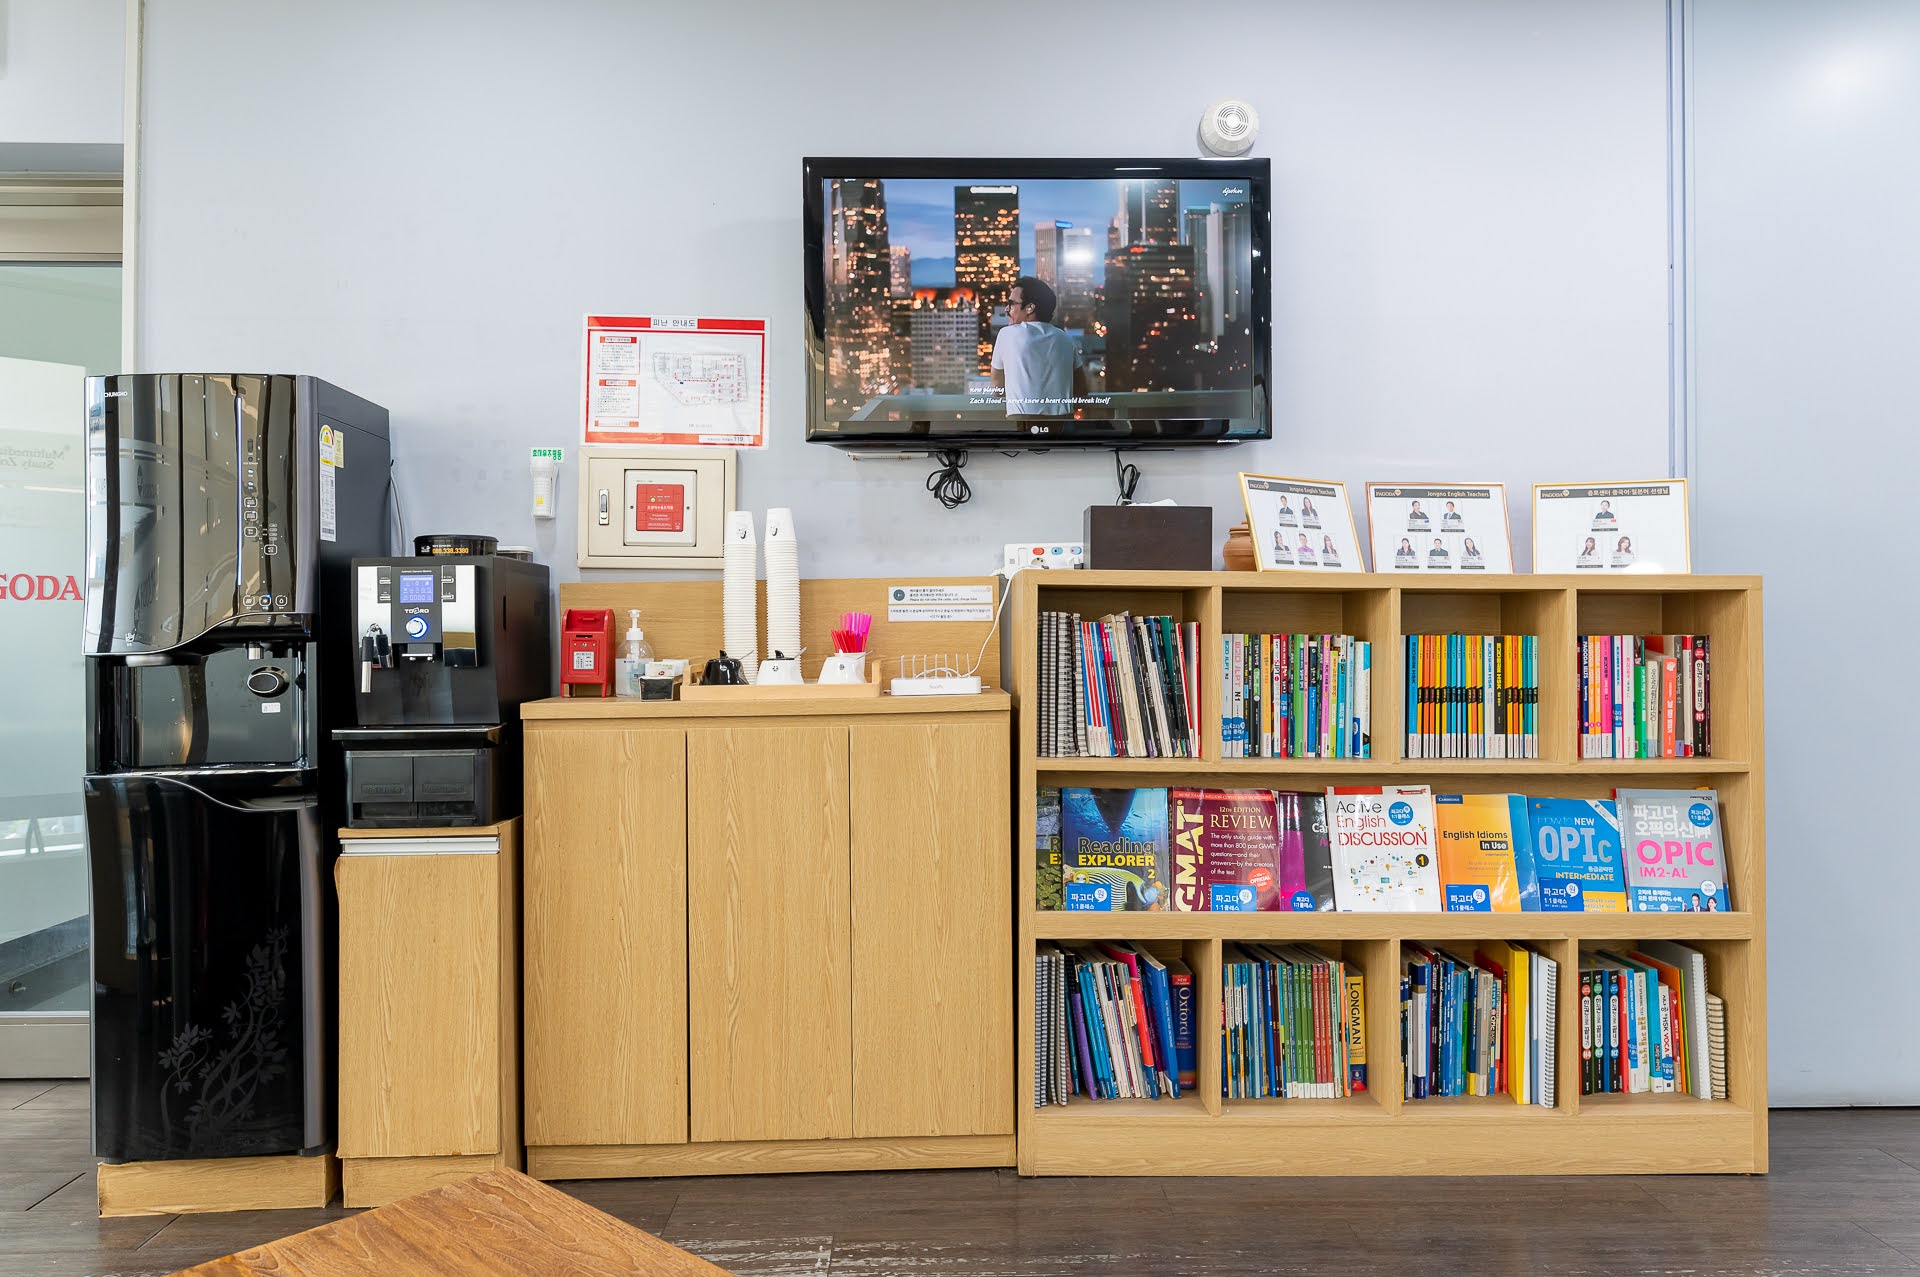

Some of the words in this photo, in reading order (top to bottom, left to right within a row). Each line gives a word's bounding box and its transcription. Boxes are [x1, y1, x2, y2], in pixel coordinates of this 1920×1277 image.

[982, 386, 1005, 394] playing
[1235, 692, 1241, 702] N1
[1633, 805, 1678, 821] 파고다
[1210, 815, 1273, 829] REVIEW
[1336, 815, 1386, 830] English
[1574, 818, 1594, 826] NEW
[1338, 832, 1427, 846] DISCUSSION
[1443, 831, 1474, 840] English
[1078, 837, 1154, 856] Reading
[1538, 826, 1613, 863] OPIc
[1636, 839, 1714, 866] OPIC
[1078, 855, 1155, 867] EXPLORER
[1419, 856, 1425, 866] 1
[1148, 869, 1155, 878] 2
[1556, 872, 1614, 881] INTERMEDIATE
[1640, 866, 1688, 878] IM2-AL
[1250, 875, 1271, 884] OFFICIAL
[1071, 893, 1094, 902] 파고다
[1544, 888, 1566, 896] 파고다
[1451, 895, 1473, 903] 파고다
[1179, 987, 1191, 1036] Oxford
[1350, 983, 1361, 1044] LONGMAN
